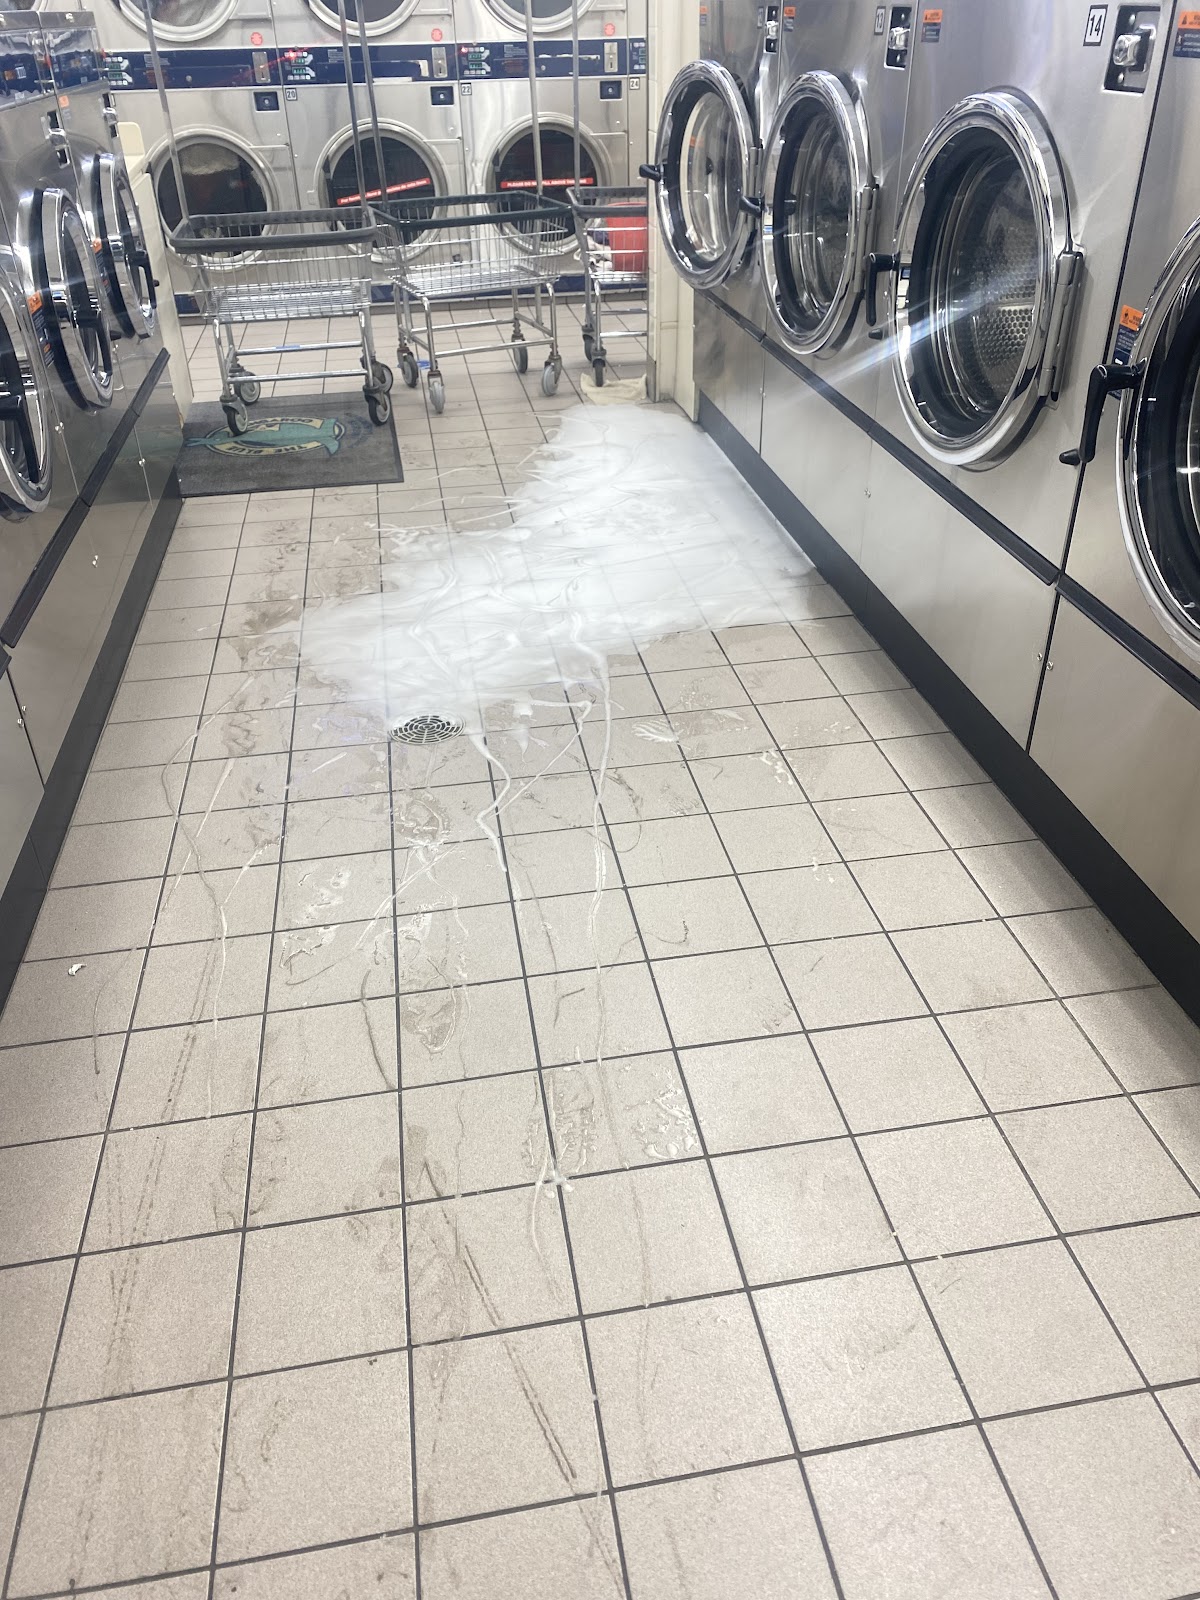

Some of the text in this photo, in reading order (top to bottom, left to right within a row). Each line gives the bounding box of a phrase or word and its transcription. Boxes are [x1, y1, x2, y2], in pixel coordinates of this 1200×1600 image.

[1089, 14, 1103, 36] 14
[226, 446, 306, 454] THE BLUE
